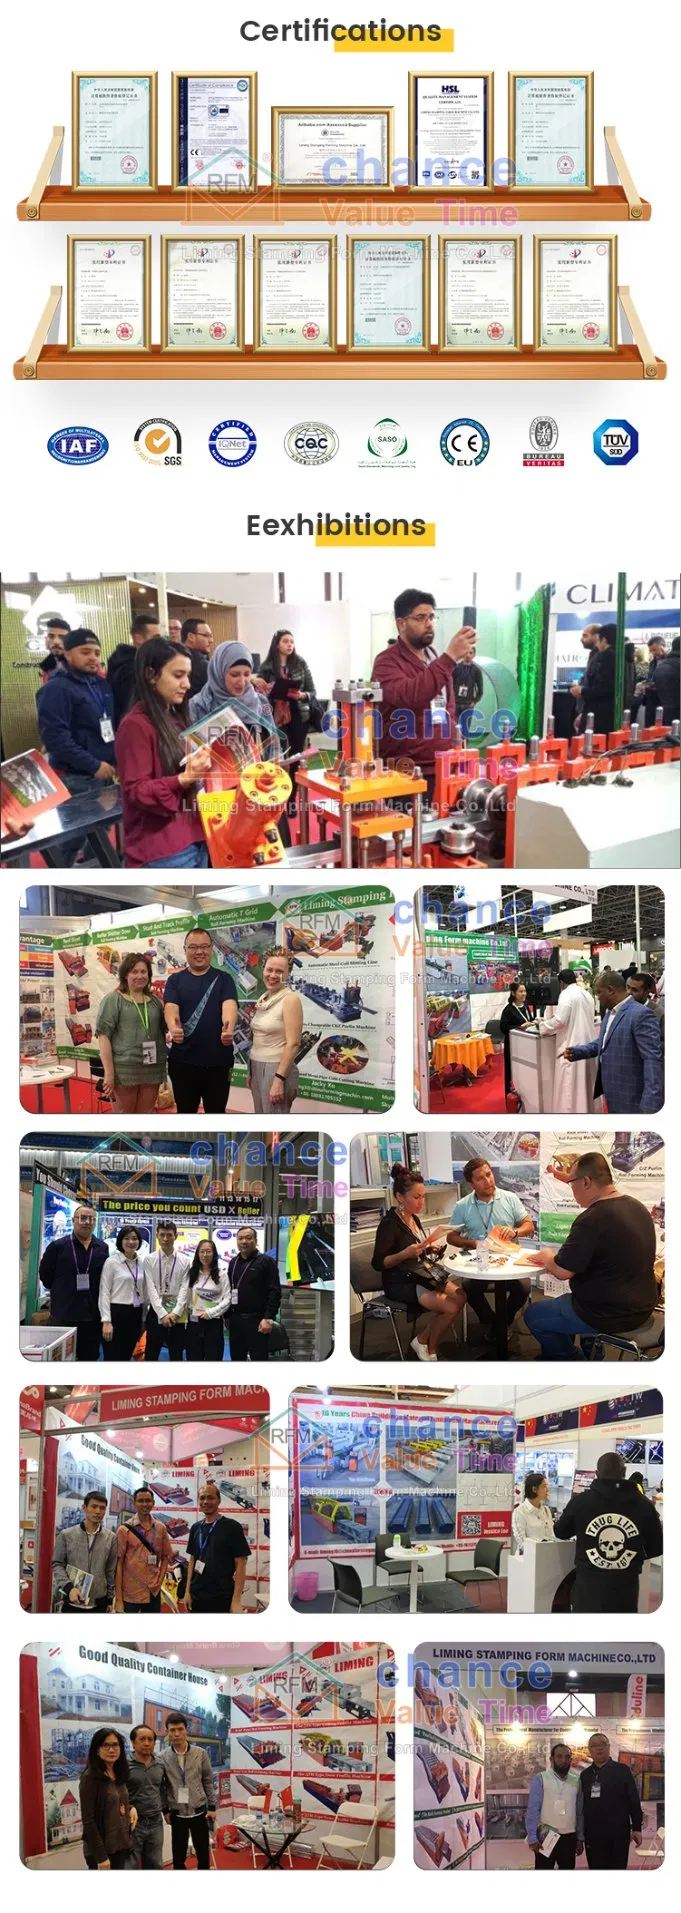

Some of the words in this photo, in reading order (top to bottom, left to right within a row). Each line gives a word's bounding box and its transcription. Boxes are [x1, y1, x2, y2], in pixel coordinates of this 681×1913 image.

[212, 422, 254, 437] CERTIFIED
[61, 439, 97, 453] IAF
[218, 440, 247, 448] IQNet
[294, 438, 328, 449] CQC
[452, 434, 477, 452] CE
[603, 434, 628, 445] TÜV
[164, 456, 182, 465] SGS
[337, 891, 386, 905] Stamping
[209, 912, 238, 921] Automatic
[103, 1200, 122, 1210] The
[124, 1201, 150, 1212] price
[153, 1203, 170, 1213] you
[173, 1202, 201, 1213] count
[204, 1206, 226, 1214] USD
[112, 1397, 142, 1411] LIMING
[146, 1390, 196, 1407] STAMPING
[200, 1387, 231, 1400] FORM
[588, 1516, 612, 1535] THUG
[617, 1517, 637, 1536] LIFE
[433, 1648, 473, 1659] LIMING
[476, 1650, 533, 1661] STAMPING
[536, 1652, 565, 1661] FORM
[79, 1645, 108, 1664] Good
[111, 1653, 145, 1672] Quality
[147, 1663, 187, 1681] Container
[188, 1672, 208, 1686] House
[335, 1656, 374, 1673] LIMING
